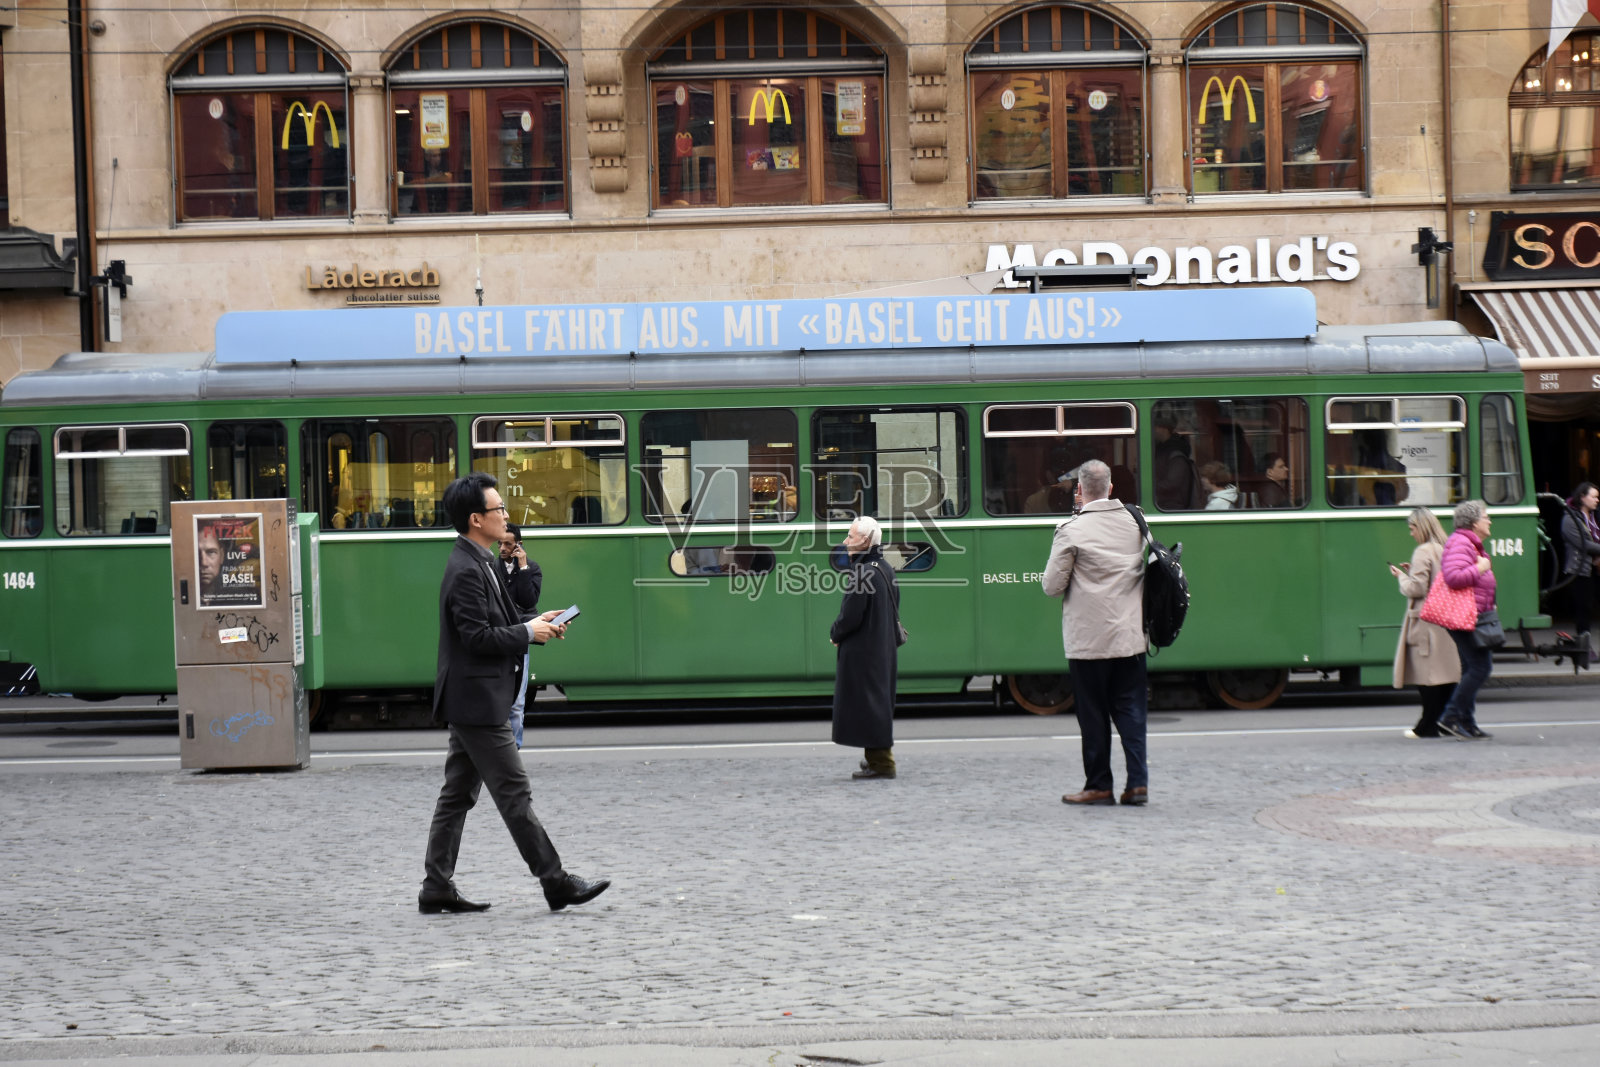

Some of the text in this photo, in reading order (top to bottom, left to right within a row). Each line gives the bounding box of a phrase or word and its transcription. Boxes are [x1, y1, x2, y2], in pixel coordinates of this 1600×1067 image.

[305, 261, 441, 290] Läderach
[346, 292, 440, 303] chocolatier suisse
[414, 310, 511, 354] BASEL
[525, 307, 625, 351] FÄHRT
[638, 305, 710, 349] AUS.
[723, 303, 782, 347] MIT
[936, 299, 1010, 342] GEHT
[1540, 373, 1560, 381] SEIT
[1540, 382, 1560, 390] 1870
[203, 525, 255, 539] FITZEK
[1490, 537, 1524, 556] 1464
[227, 551, 247, 560] LIVE
[3, 571, 36, 590] 1464
[222, 573, 256, 584] BASEL
[983, 573, 1020, 584] BASEL
